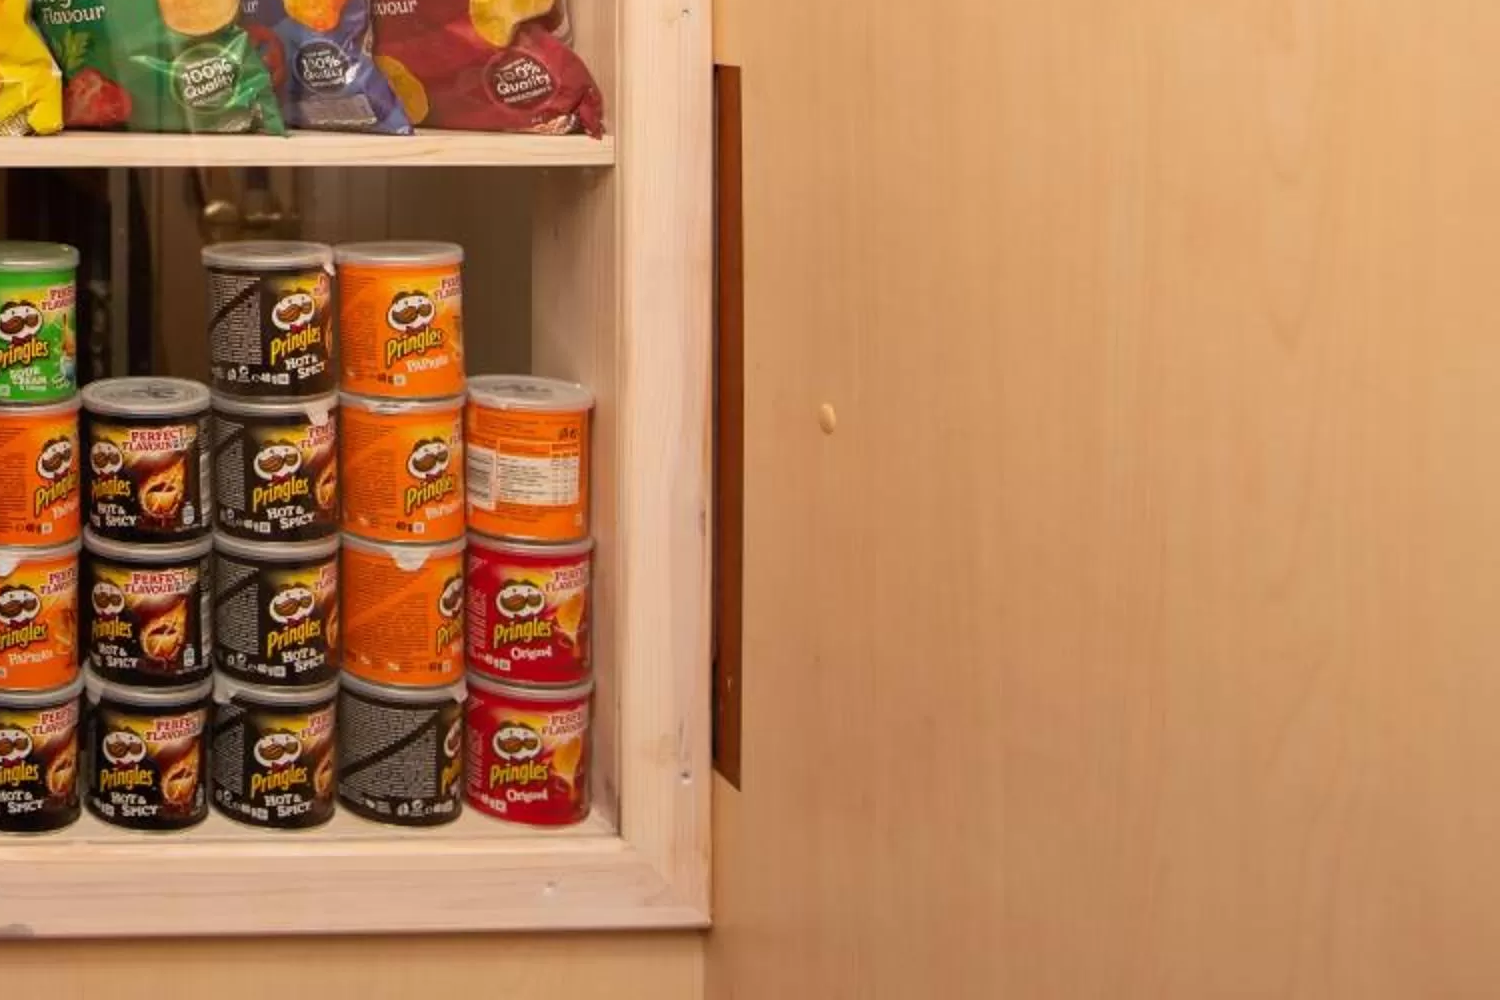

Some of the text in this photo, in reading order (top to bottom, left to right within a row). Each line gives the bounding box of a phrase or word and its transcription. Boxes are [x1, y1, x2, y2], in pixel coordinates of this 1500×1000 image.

[182, 59, 233, 85] 100%
[184, 73, 235, 99] Quality
[270, 325, 322, 367] Pringles
[386, 325, 443, 369] Pringles
[253, 475, 310, 513] Pringles
[279, 513, 316, 530] SPICY
[267, 616, 321, 659] Pringles
[493, 616, 552, 649] Pringles
[100, 764, 153, 793] Pringles
[252, 764, 308, 797] Pringles
[490, 761, 548, 789] Pringles
